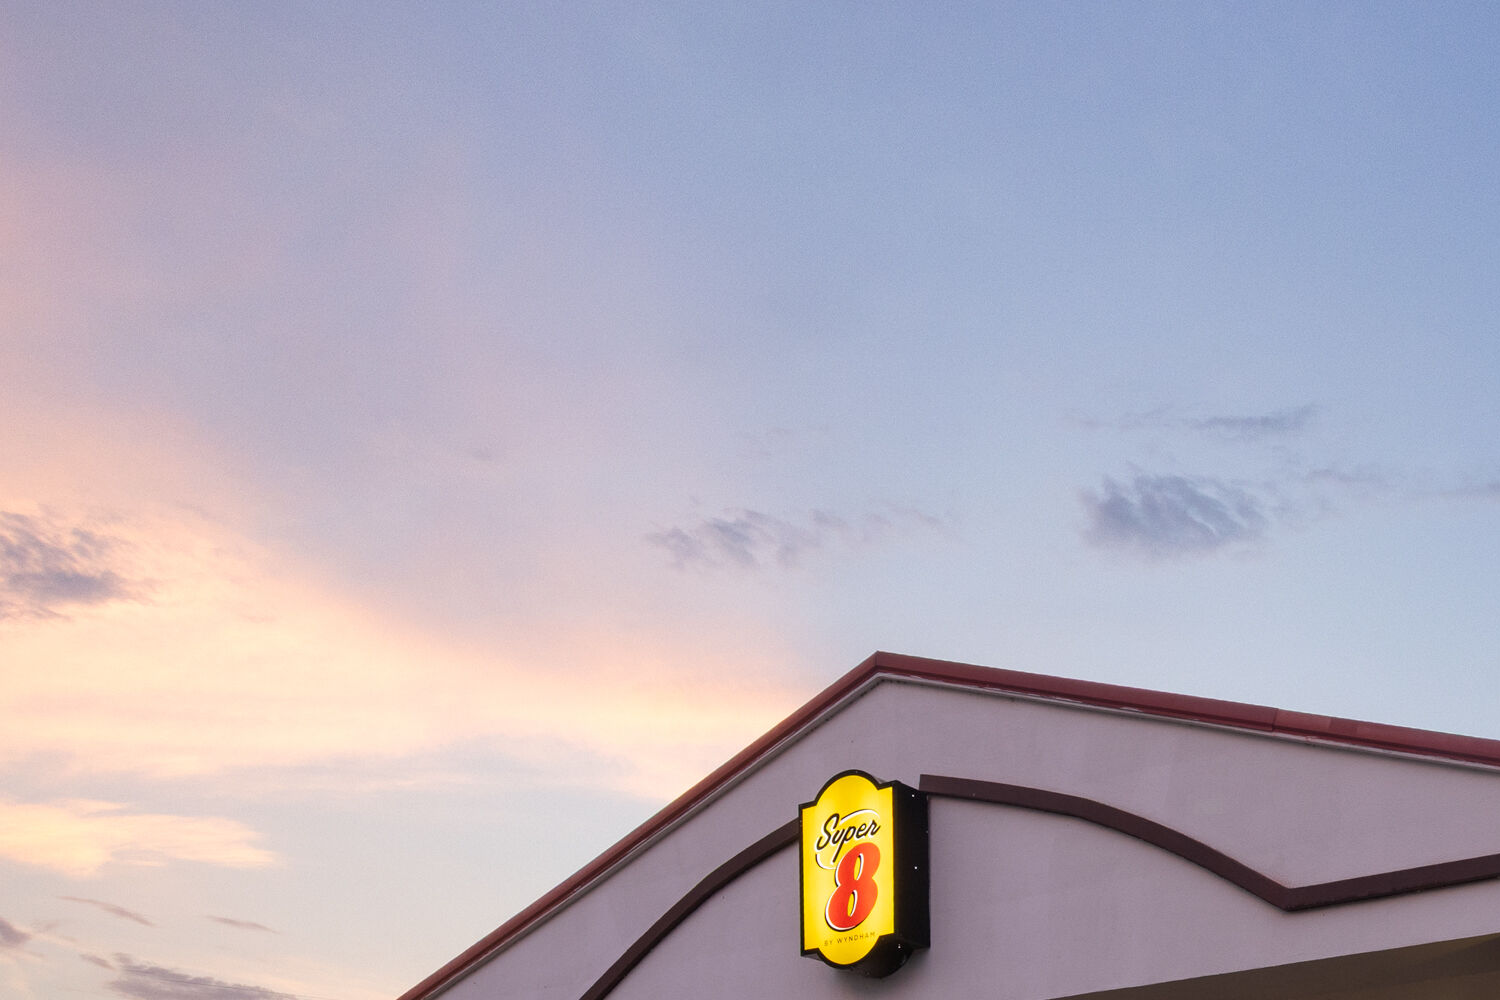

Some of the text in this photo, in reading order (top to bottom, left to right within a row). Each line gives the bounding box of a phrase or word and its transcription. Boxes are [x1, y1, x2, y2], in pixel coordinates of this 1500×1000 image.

[815, 811, 881, 864] Super
[825, 842, 881, 932] 8
[837, 931, 876, 944] WYNDHAM
